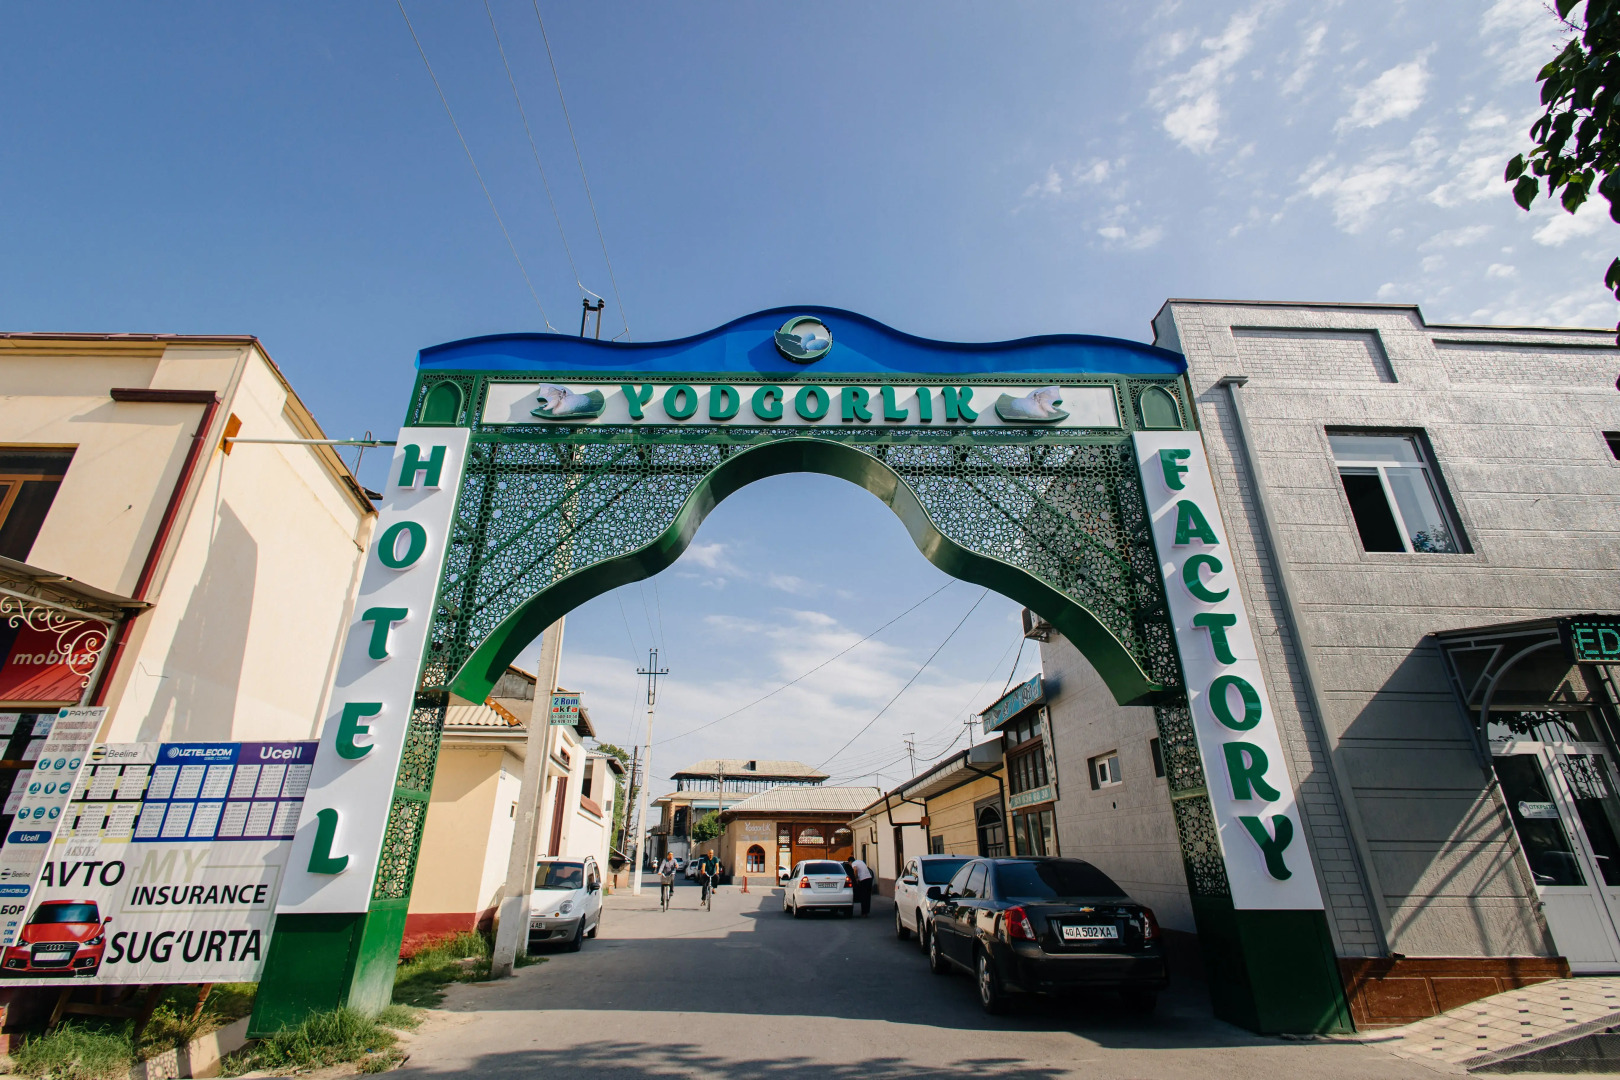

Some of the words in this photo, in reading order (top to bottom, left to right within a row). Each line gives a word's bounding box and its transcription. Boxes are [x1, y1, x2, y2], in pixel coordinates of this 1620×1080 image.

[620, 382, 980, 423] YODGORLIK
[306, 443, 448, 875] HOTEL
[1156, 448, 1294, 881] FACTORY
[554, 697, 559, 705] 2
[107, 749, 139, 758] Beeline
[179, 748, 233, 757] UZTELECOM
[259, 746, 303, 760] Ucell
[20, 833, 40, 842] Ucell
[11, 870, 31, 878] Beeline
[40, 860, 126, 887] AVTO
[137, 849, 209, 883] MY
[130, 884, 269, 906] INSURANCE
